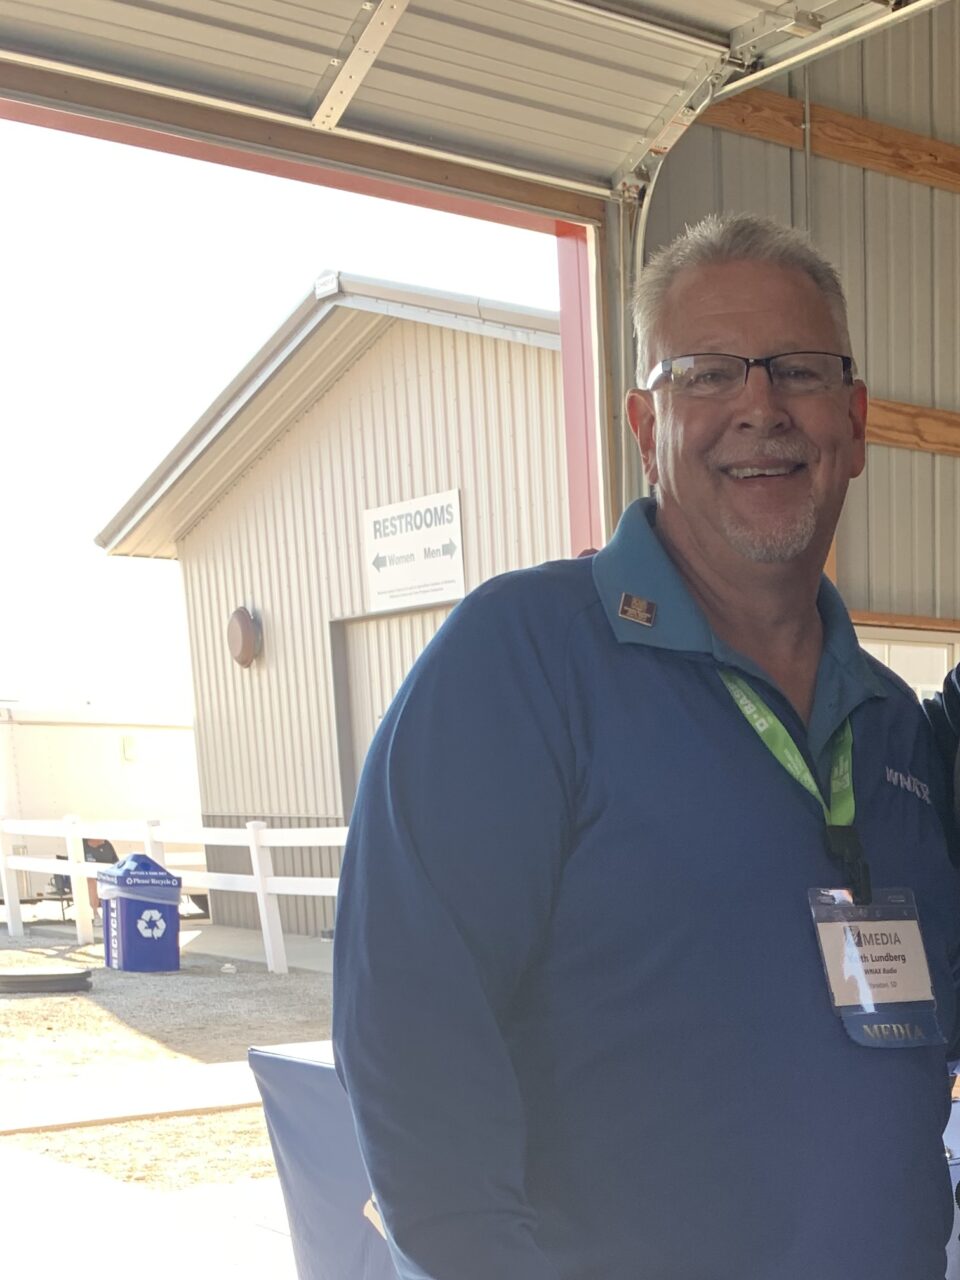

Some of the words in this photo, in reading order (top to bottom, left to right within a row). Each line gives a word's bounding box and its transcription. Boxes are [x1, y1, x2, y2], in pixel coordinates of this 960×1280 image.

[373, 503, 454, 540] RESTROOMS
[388, 552, 415, 567] Women
[423, 546, 441, 560] Men
[110, 898, 118, 969] RECYCLE
[862, 932, 901, 946] MEDIA
[870, 953, 906, 964] Lundberg
[863, 1024, 926, 1040] MEDIA
